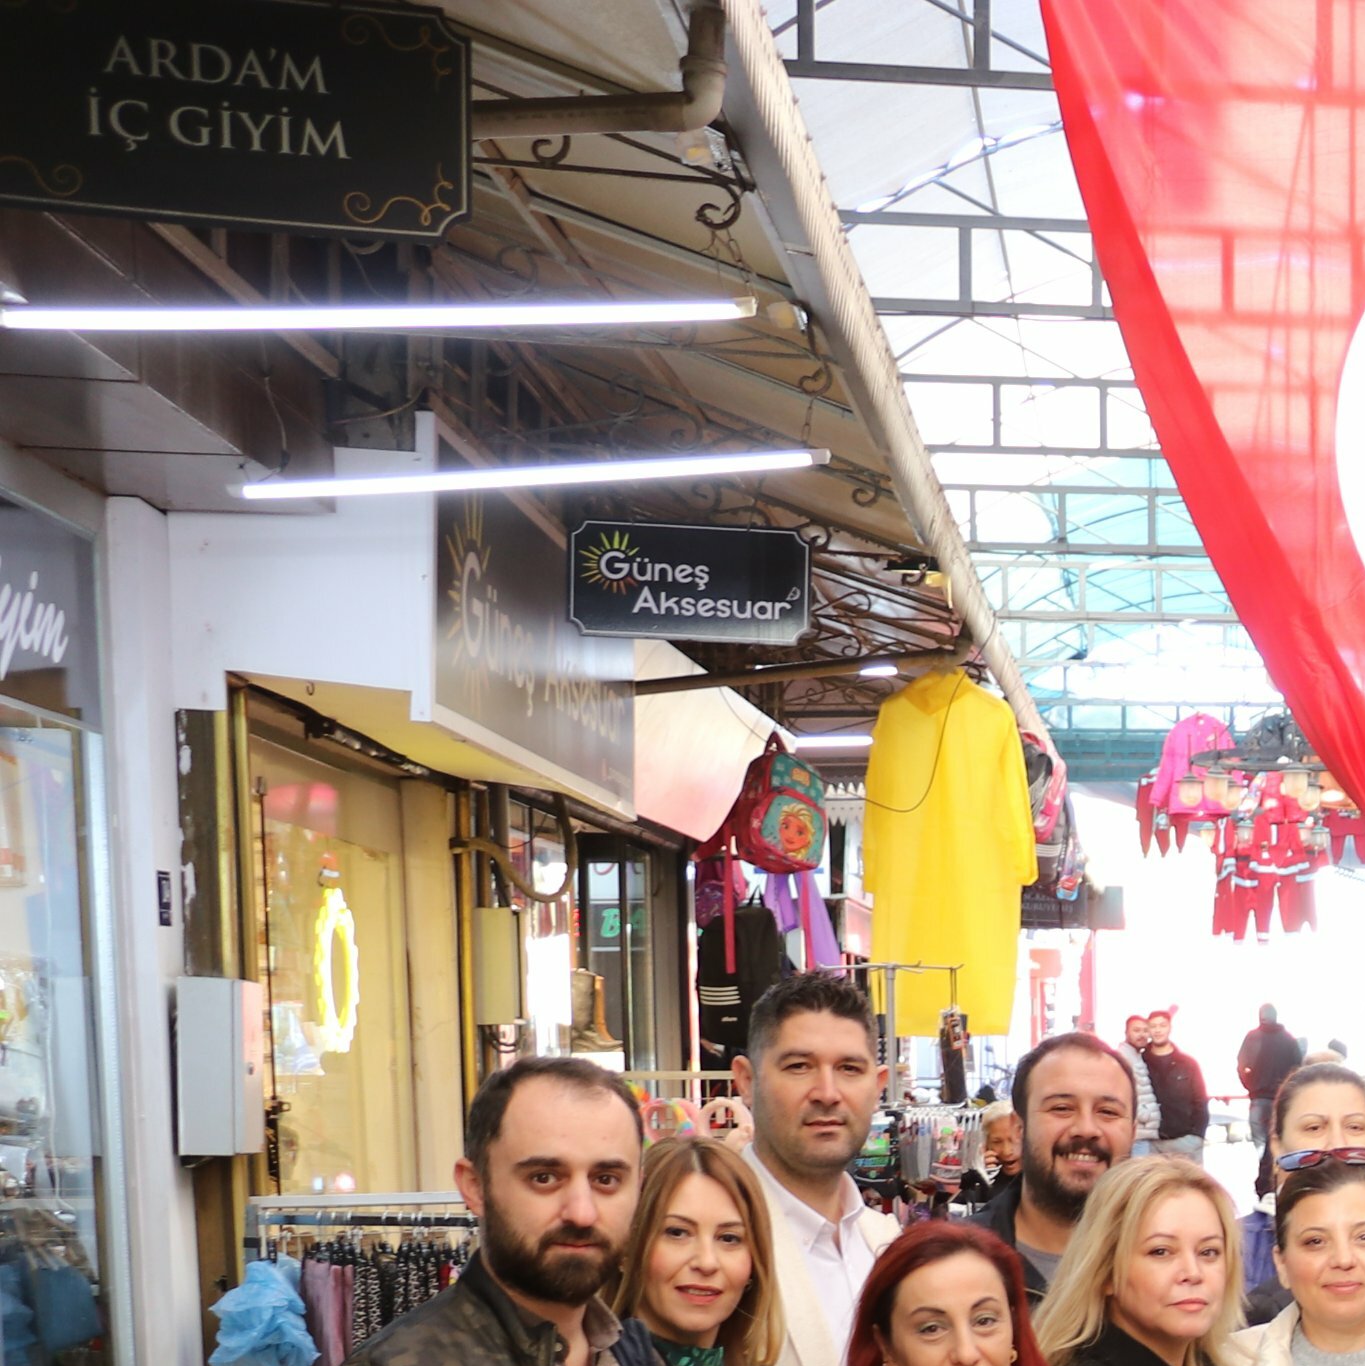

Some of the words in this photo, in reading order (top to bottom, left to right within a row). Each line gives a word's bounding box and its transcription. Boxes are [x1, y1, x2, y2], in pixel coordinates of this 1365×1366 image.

[103, 34, 331, 94] ARDA'M
[87, 86, 150, 151] İÇ
[168, 101, 352, 159] GİYİM
[599, 550, 710, 590] Güneş
[631, 585, 792, 620] Aksesuar
